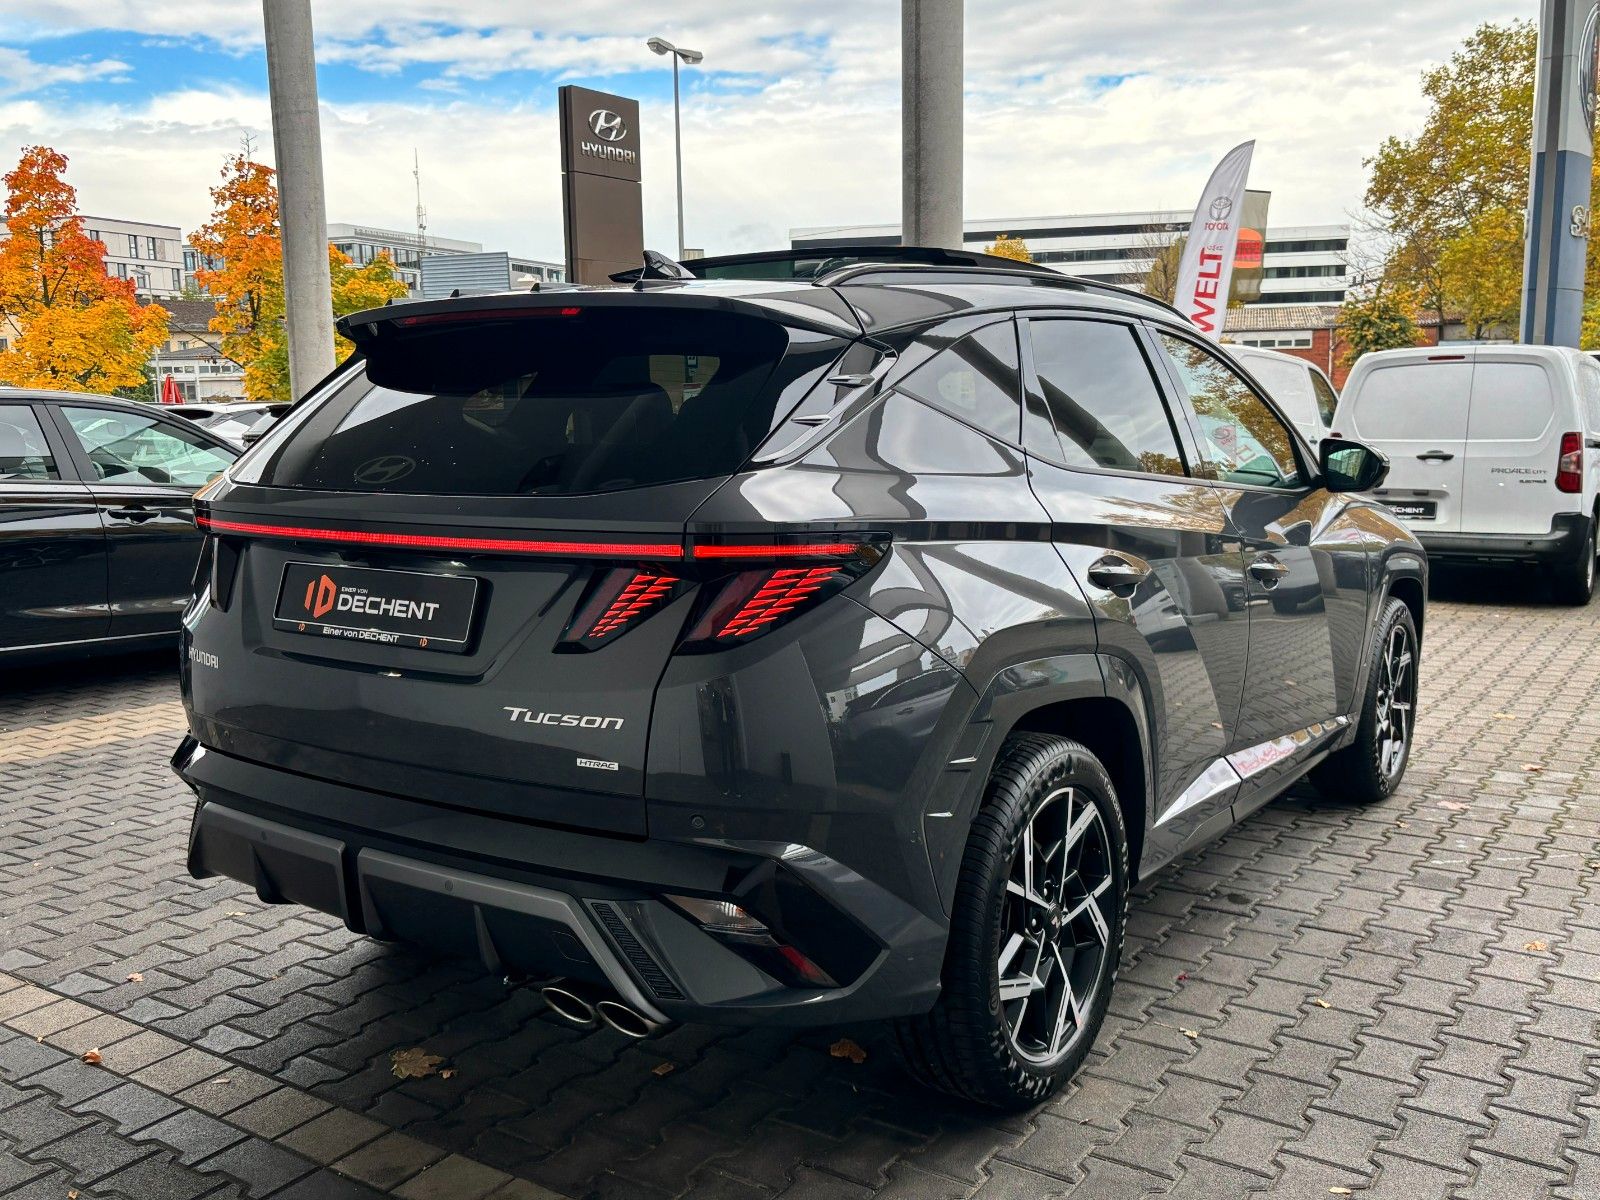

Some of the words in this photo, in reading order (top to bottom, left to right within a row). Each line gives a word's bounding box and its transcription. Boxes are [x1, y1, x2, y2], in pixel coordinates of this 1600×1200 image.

[581, 141, 636, 164] HYUNDAI
[1204, 222, 1229, 231] TOYOTA
[1491, 467, 1531, 475] PROACE
[1389, 506, 1424, 514] ECHENT
[337, 593, 440, 621] DECHENT
[322, 626, 342, 637] Einer
[343, 629, 358, 638] von
[358, 631, 400, 643] DECHENT
[188, 645, 219, 669] HYUNDAI
[579, 759, 616, 770] HTRAC
